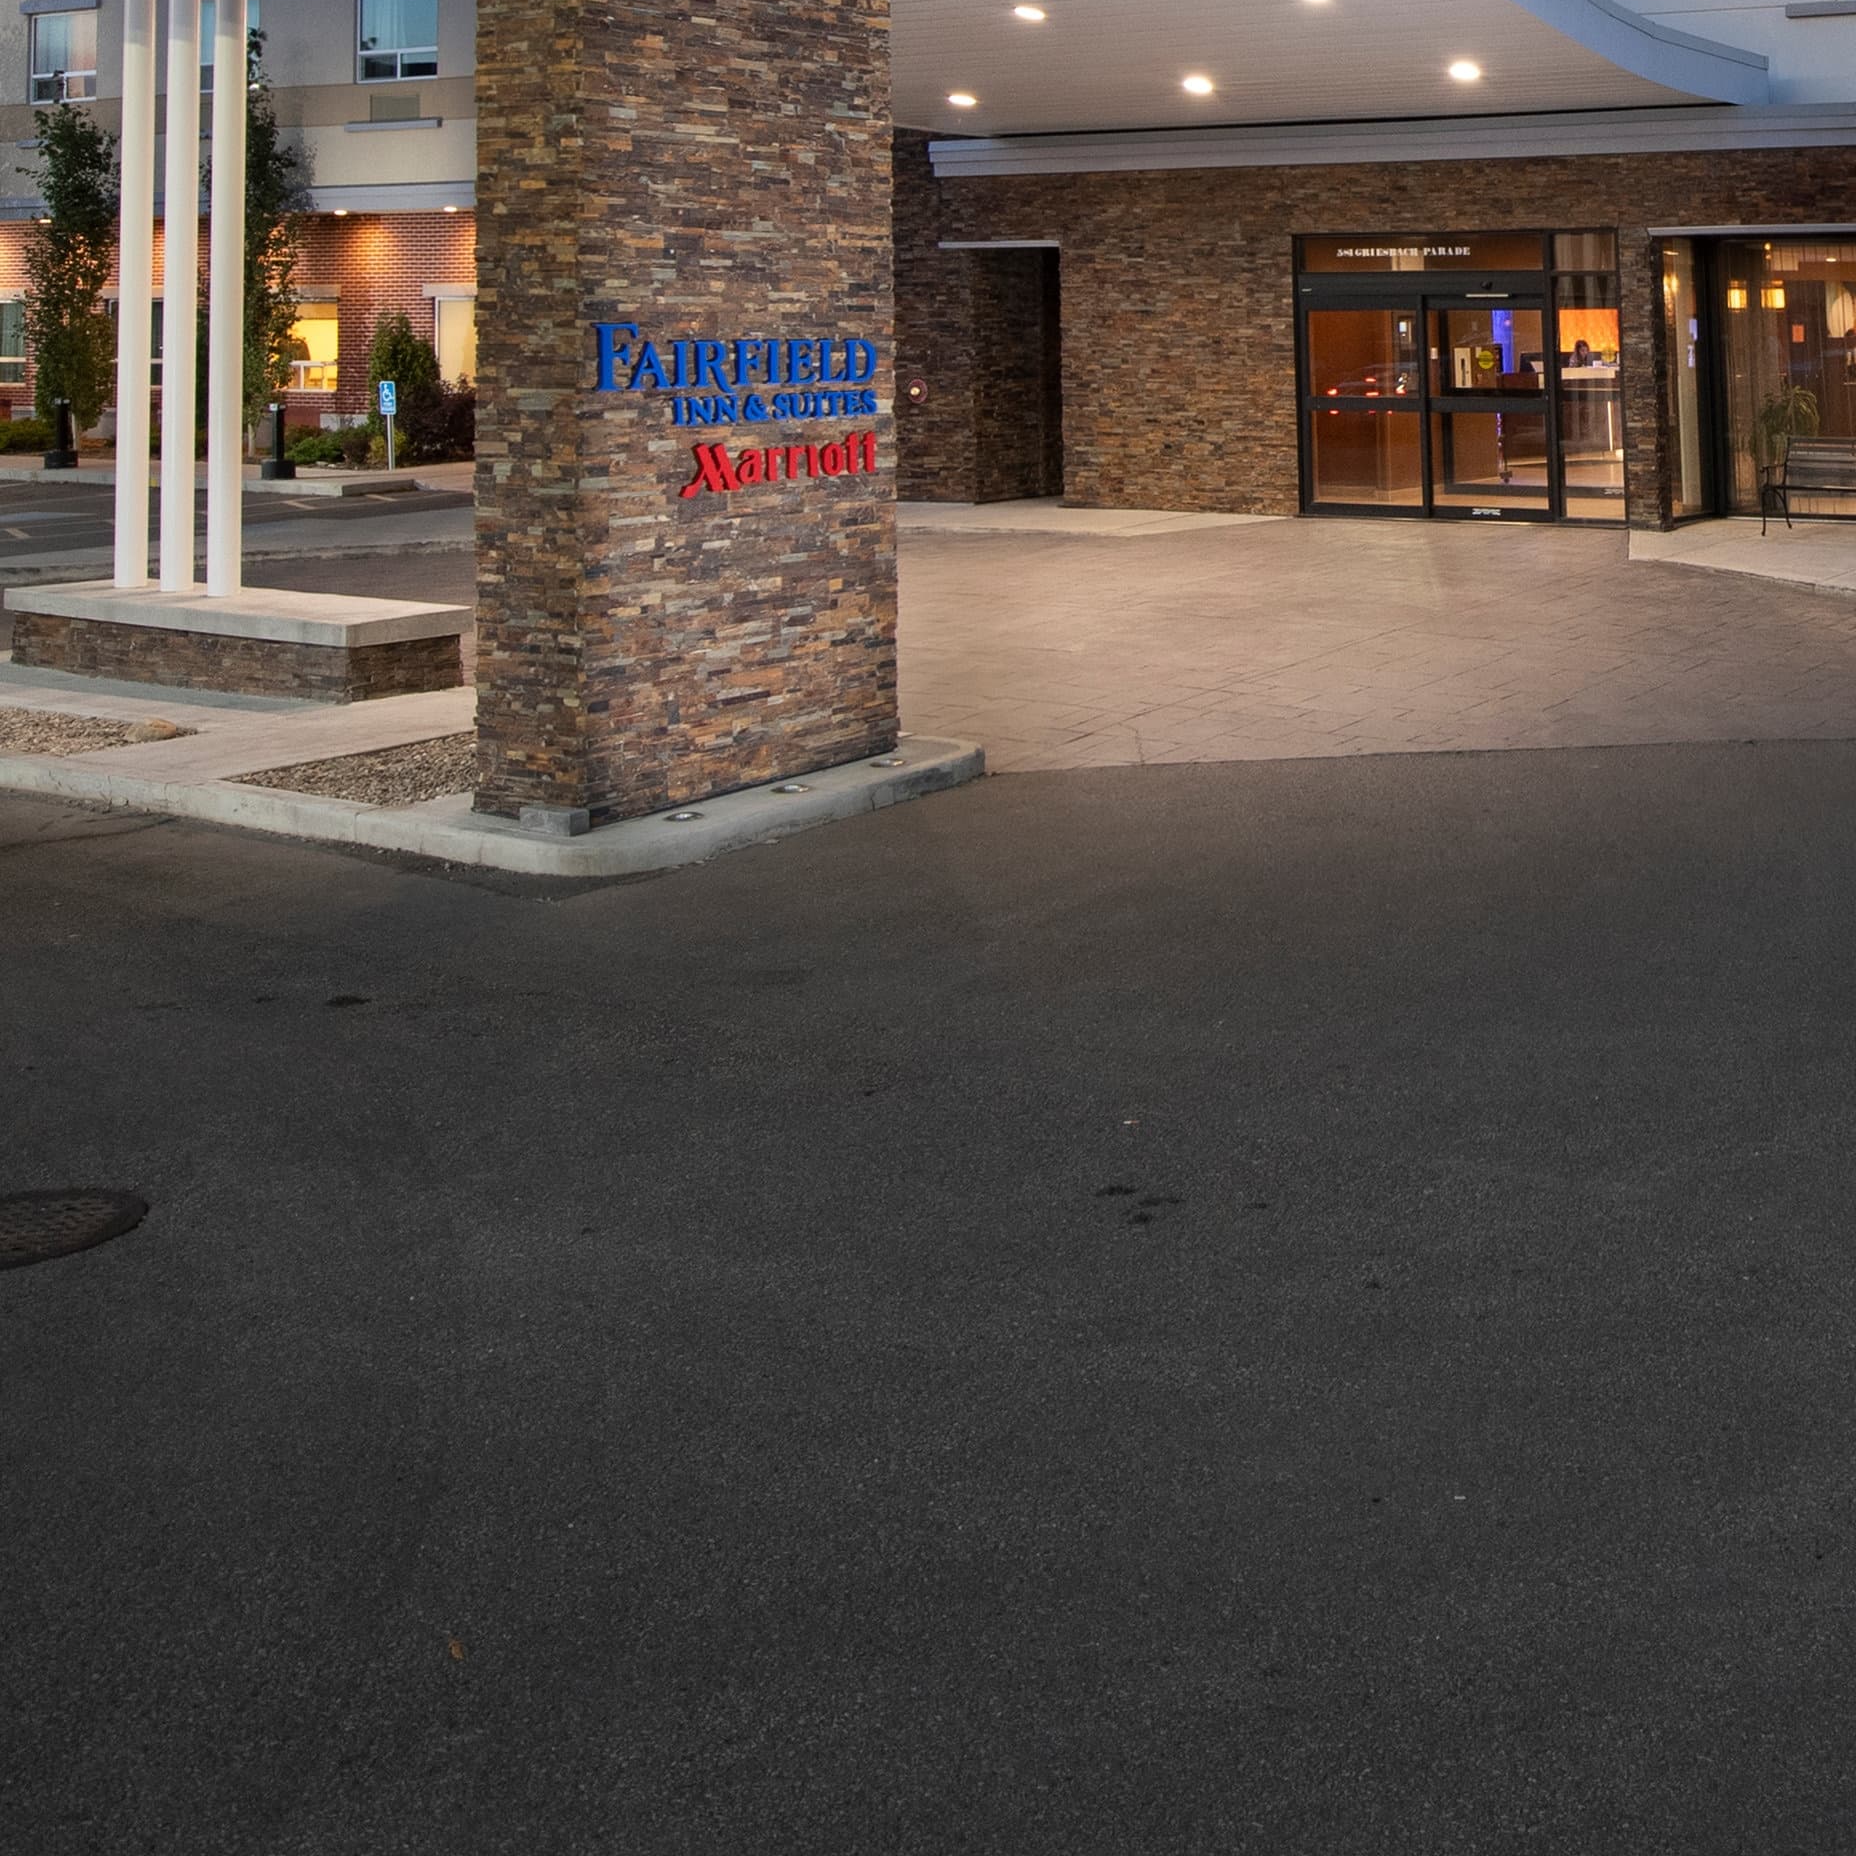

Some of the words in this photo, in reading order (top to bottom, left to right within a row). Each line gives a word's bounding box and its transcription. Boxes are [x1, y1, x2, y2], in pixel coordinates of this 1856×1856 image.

[1423, 246, 1471, 256] PARADE
[592, 321, 878, 394] FAIRFIELD
[672, 394, 740, 426] INN
[744, 393, 770, 421] &
[772, 389, 877, 420] SUITES
[680, 431, 877, 499] Marriott
